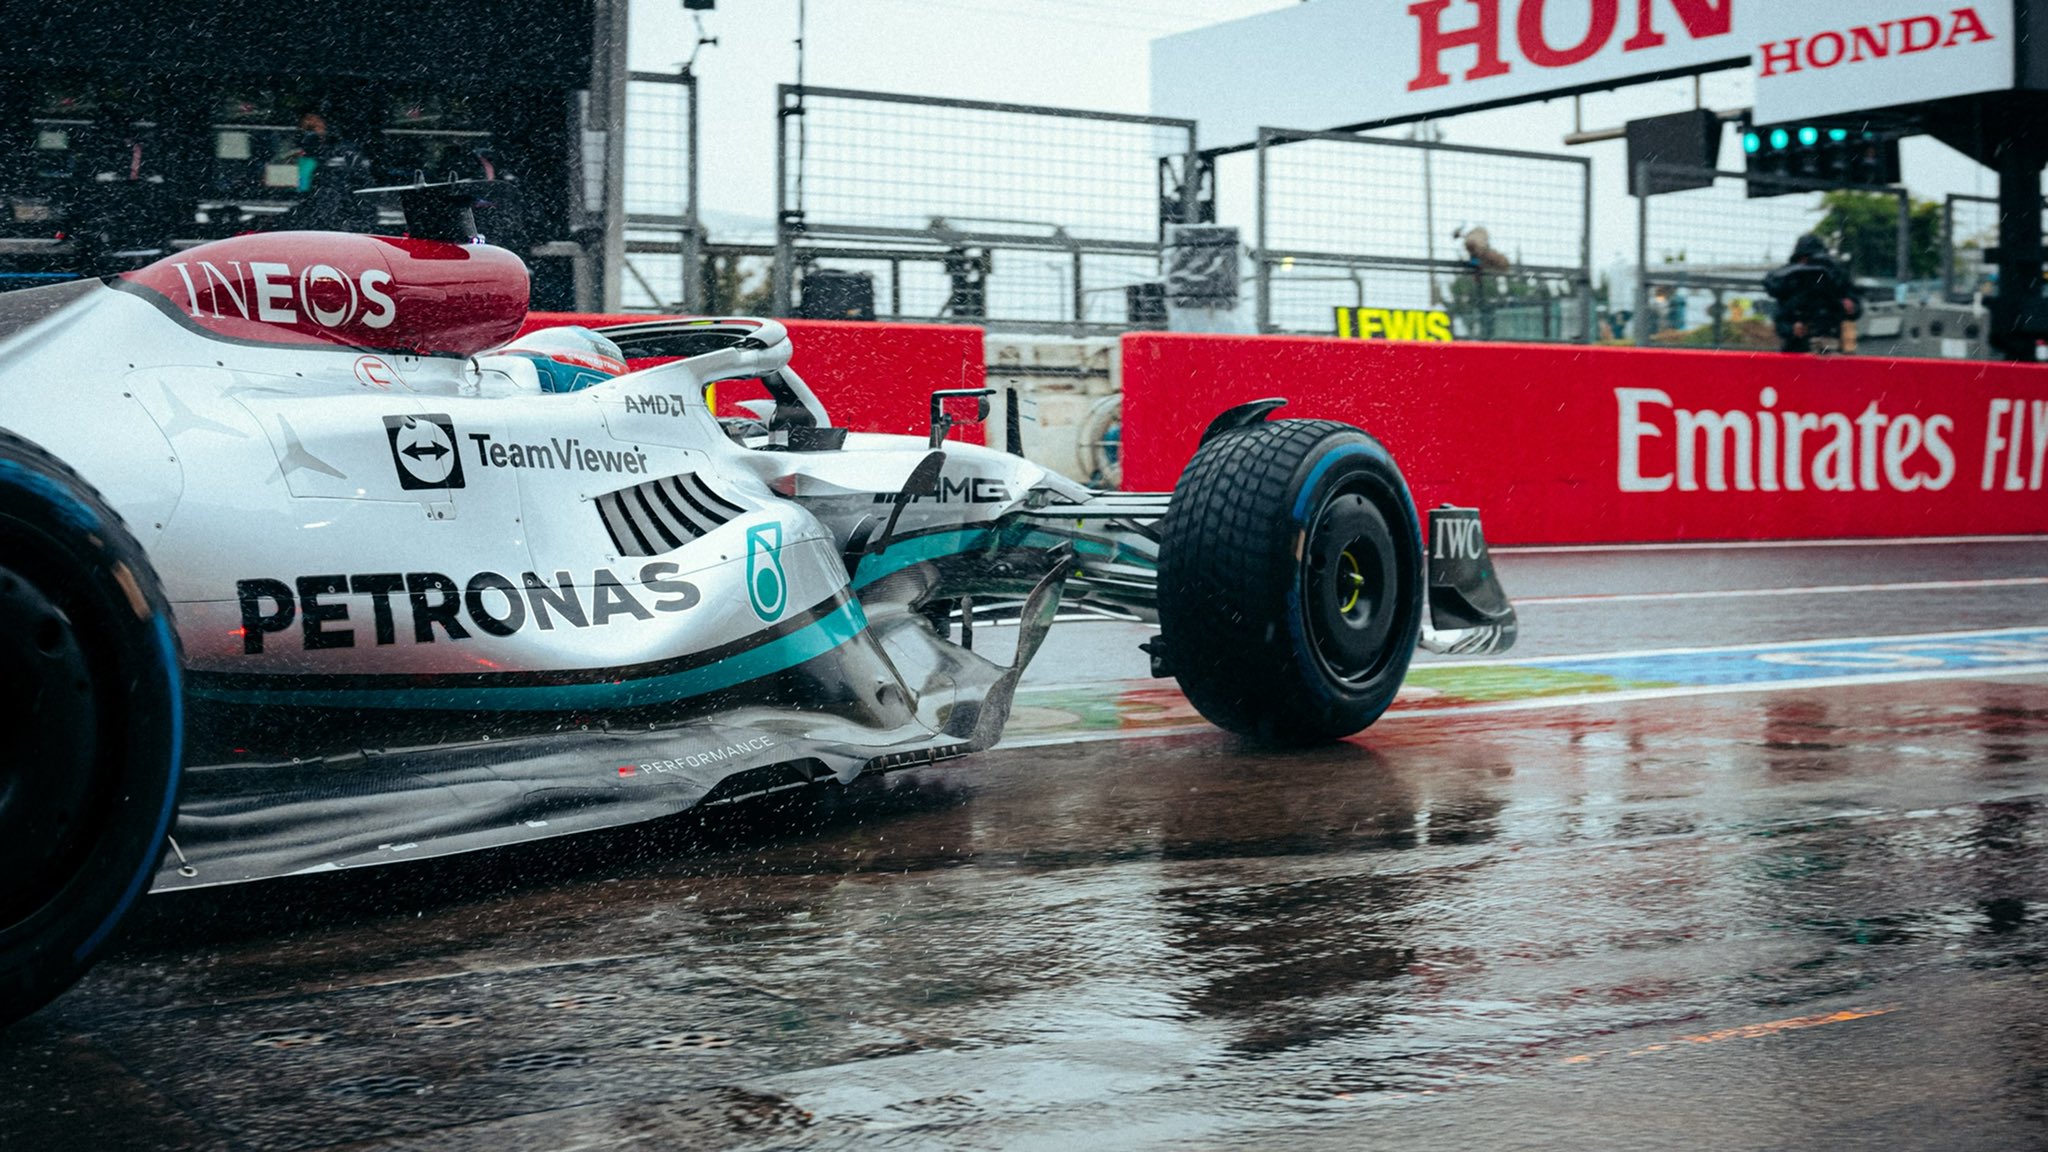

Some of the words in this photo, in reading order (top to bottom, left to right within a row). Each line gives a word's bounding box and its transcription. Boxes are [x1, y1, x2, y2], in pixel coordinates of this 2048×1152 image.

[1759, 8, 1995, 78] HONDA
[172, 261, 397, 329] INEOS
[625, 394, 670, 416] AMD
[468, 433, 648, 475] TeamViewer
[1614, 386, 1956, 492] Emirates
[1981, 398, 2048, 492] FLY
[1433, 518, 1482, 560] IWC
[236, 561, 702, 655] PETRONAS
[640, 735, 775, 775] PERFORMANCE
